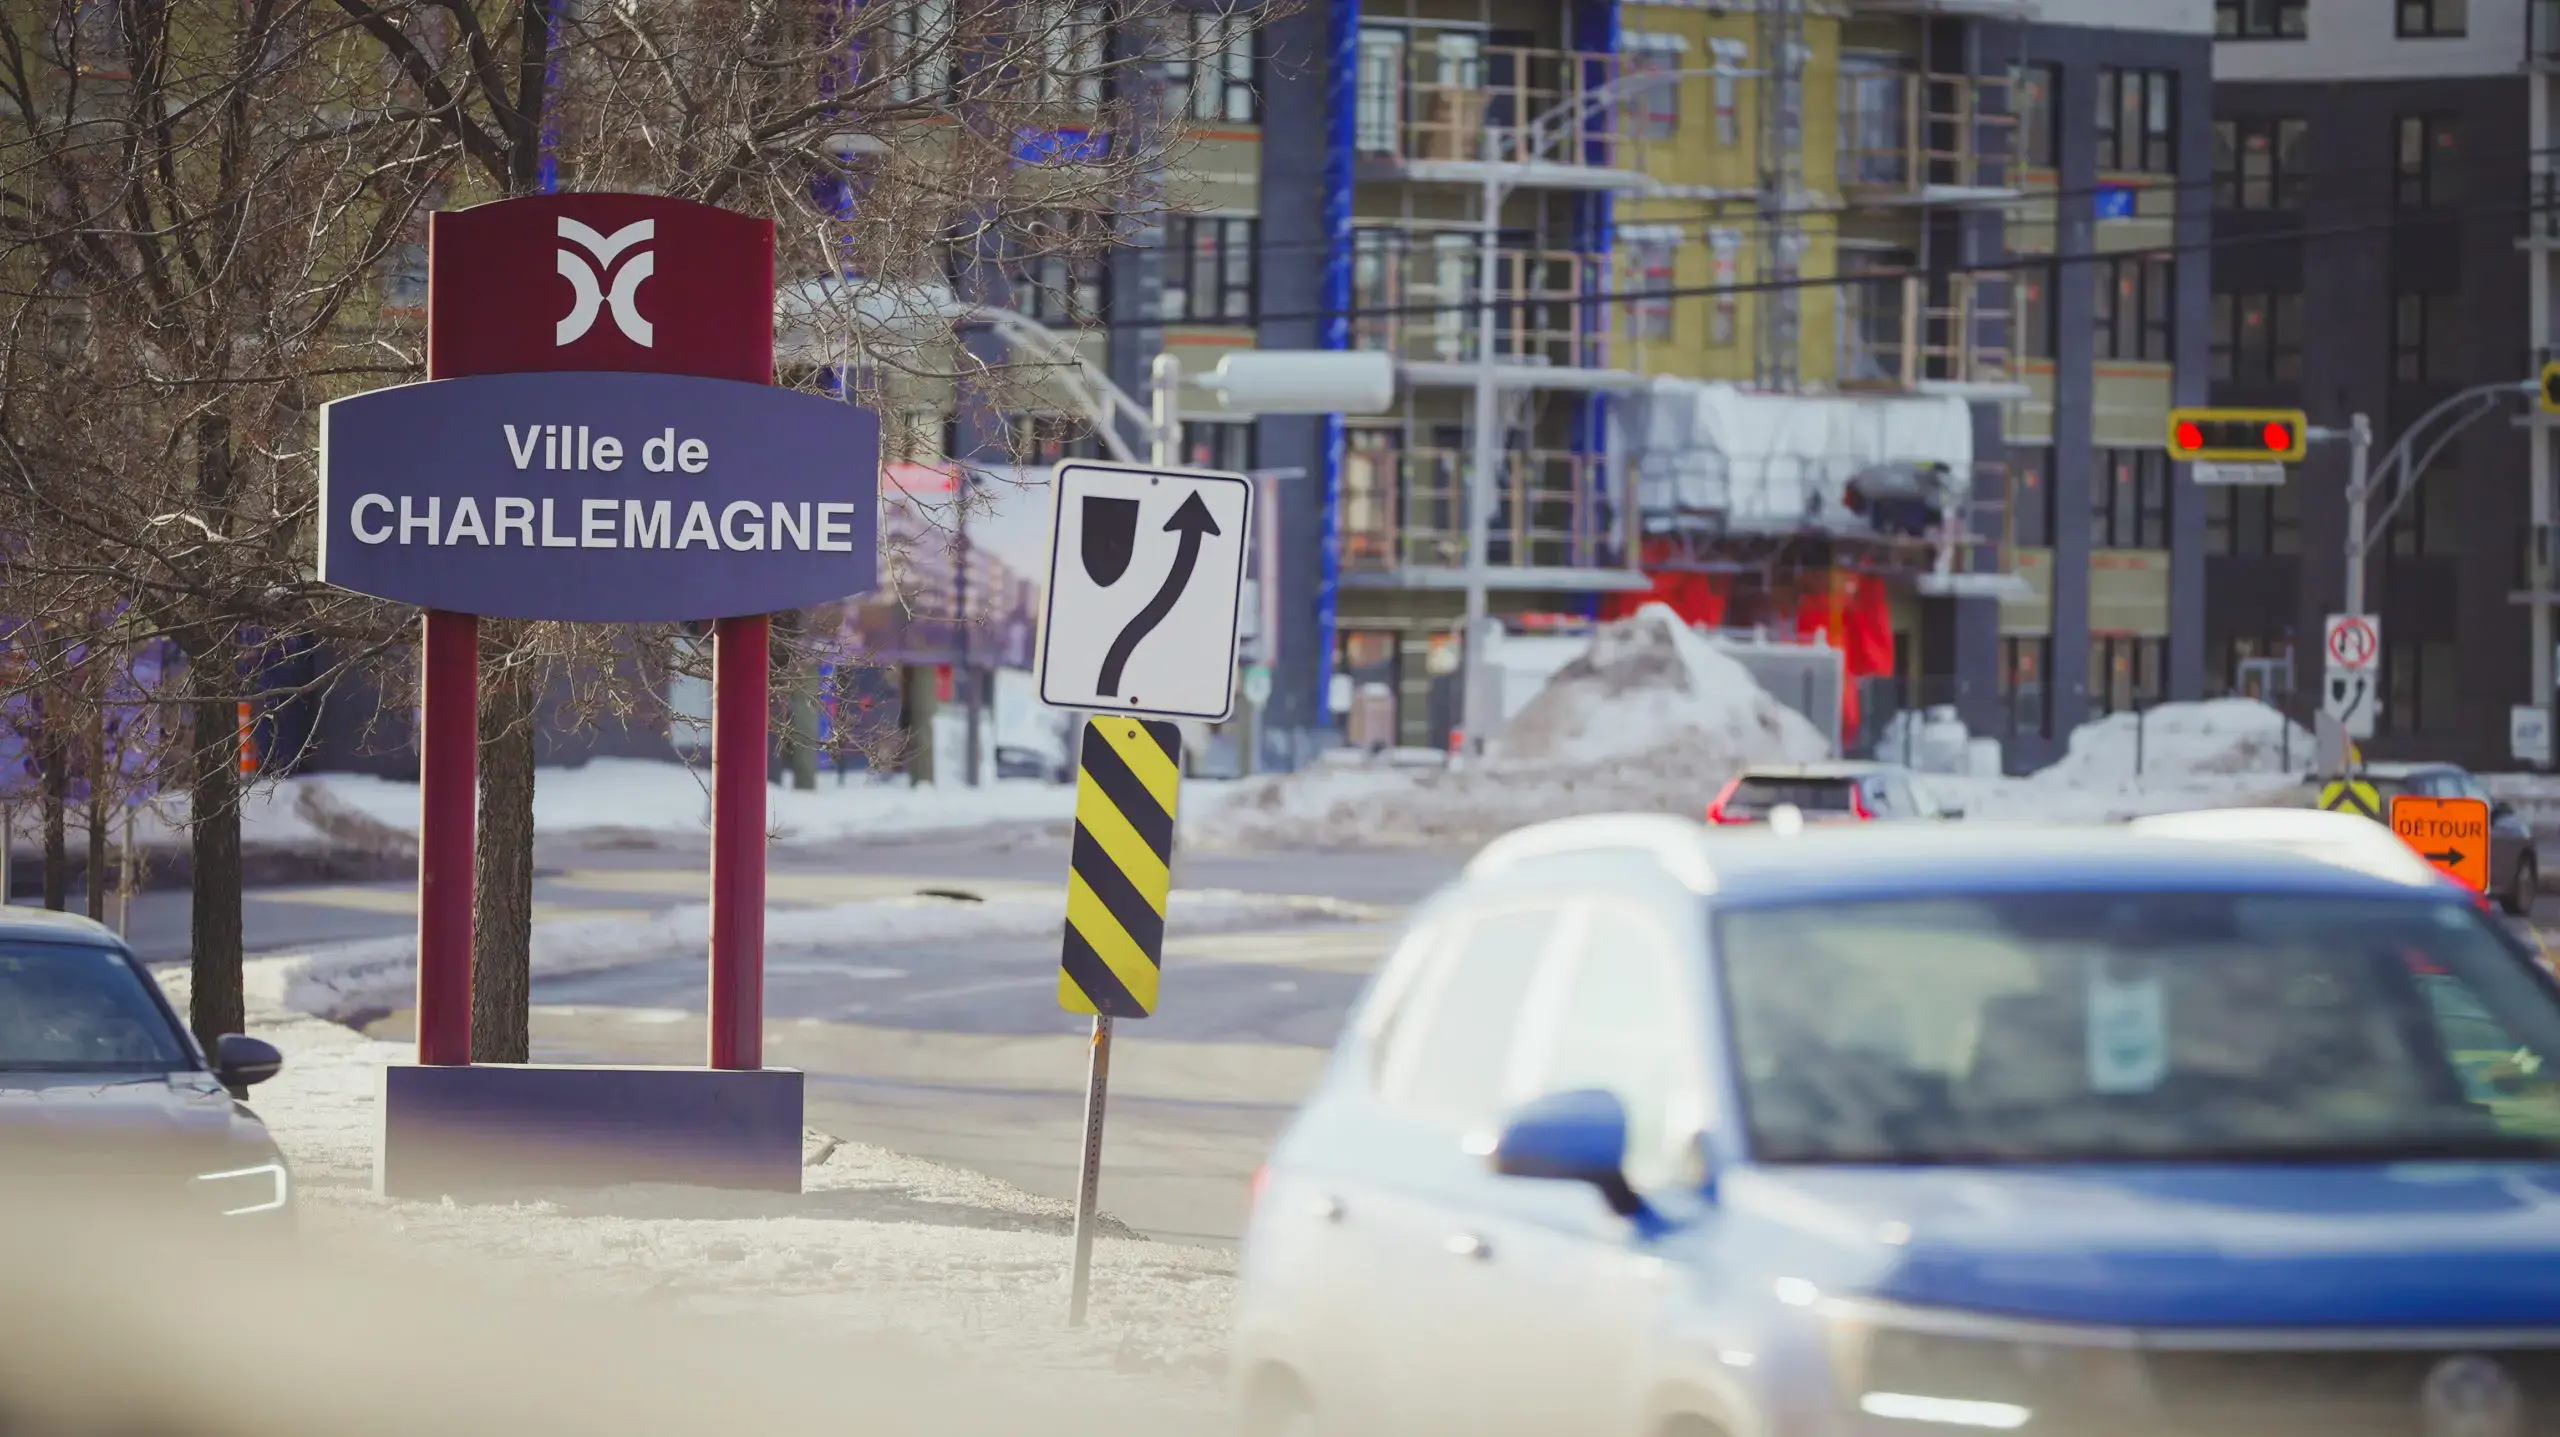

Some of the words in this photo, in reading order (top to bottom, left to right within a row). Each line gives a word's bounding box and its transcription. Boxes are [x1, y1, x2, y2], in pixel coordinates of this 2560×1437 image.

[503, 424, 624, 473] Ville
[642, 427, 709, 473] de
[350, 493, 855, 552] CHARLEMAGNE
[2399, 816, 2482, 838] DÉTOUR
